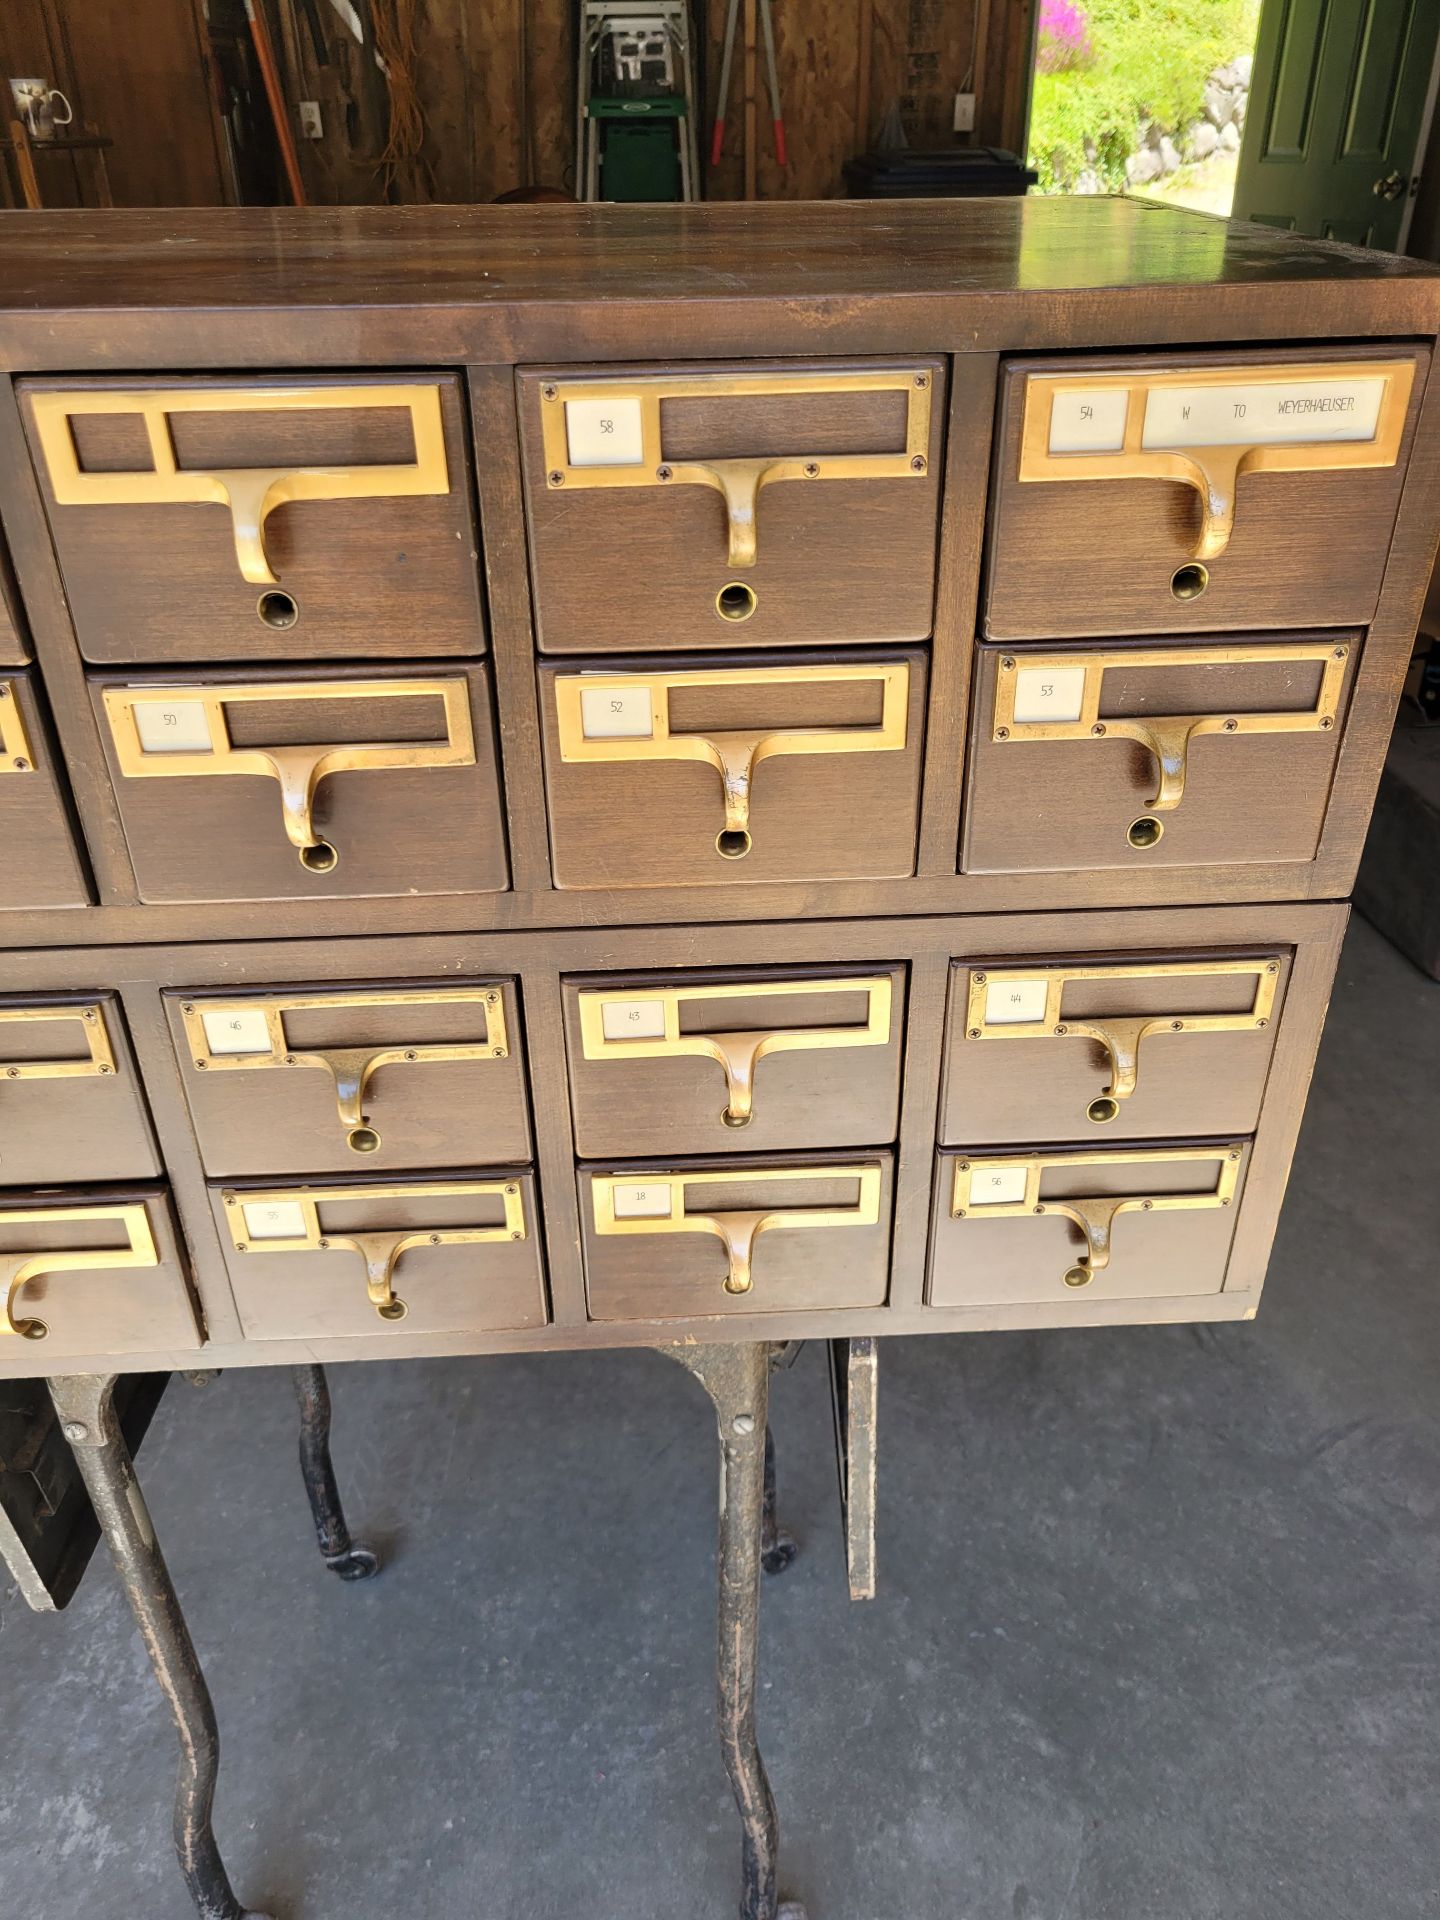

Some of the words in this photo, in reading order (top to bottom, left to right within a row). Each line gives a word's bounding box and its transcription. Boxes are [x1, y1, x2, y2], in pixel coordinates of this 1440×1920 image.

[1079, 405, 1093, 421] 54
[1182, 405, 1191, 420] W
[1233, 404, 1247, 419] TO
[1278, 397, 1355, 414] WEYERHAEUSER
[599, 419, 614, 434] 58
[1040, 684, 1054, 697] 53
[610, 700, 623, 713] 52
[635, 1191, 646, 1201] 18
